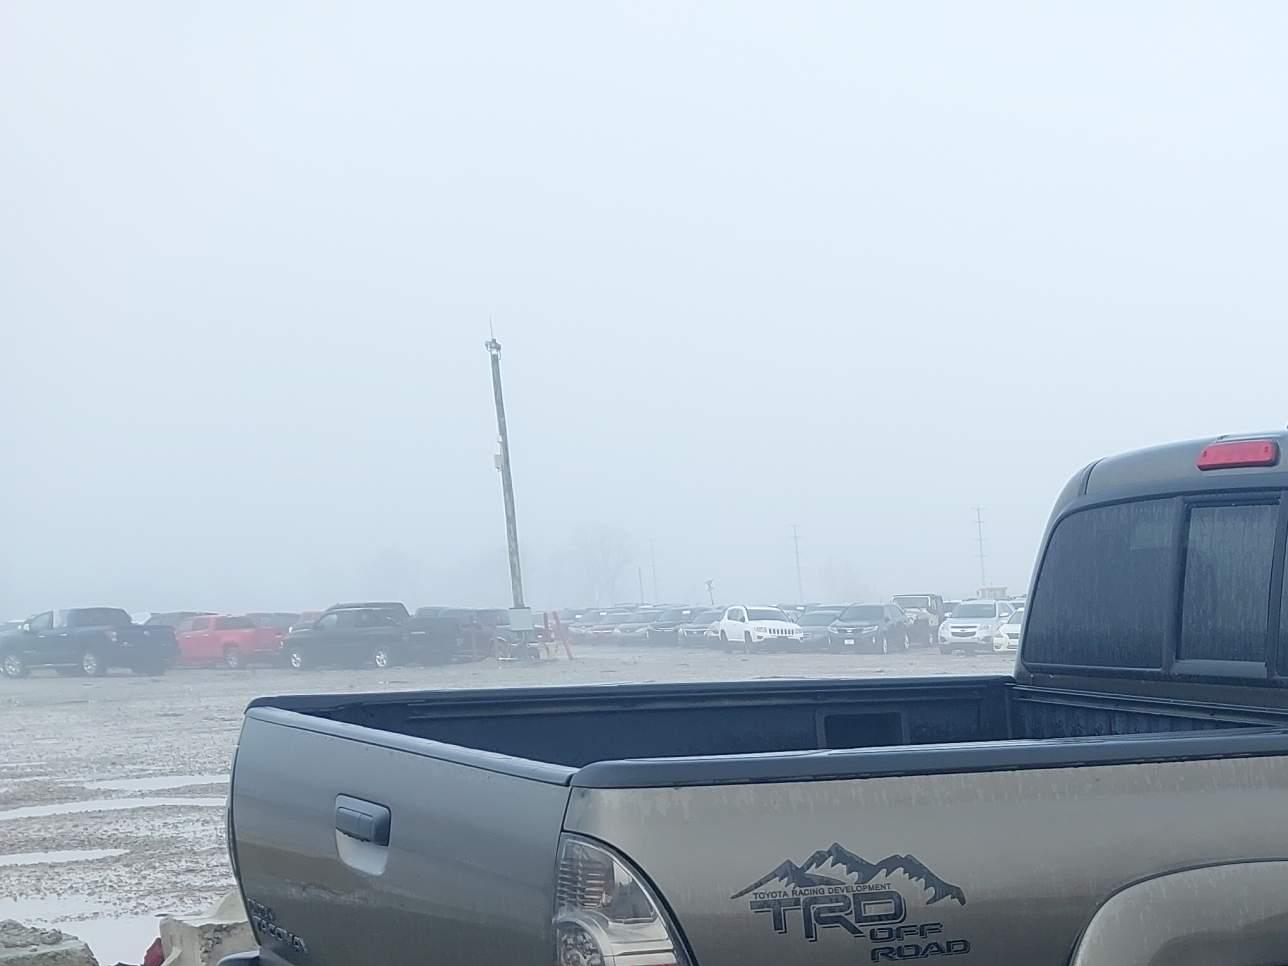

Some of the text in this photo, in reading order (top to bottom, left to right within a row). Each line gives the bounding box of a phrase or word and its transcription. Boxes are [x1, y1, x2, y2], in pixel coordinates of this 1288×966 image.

[753, 883, 891, 900] TOYOTA RACING DEVELOPMENT
[750, 890, 907, 942] TRD
[869, 922, 943, 943] OFF
[871, 939, 971, 963] ROAD
